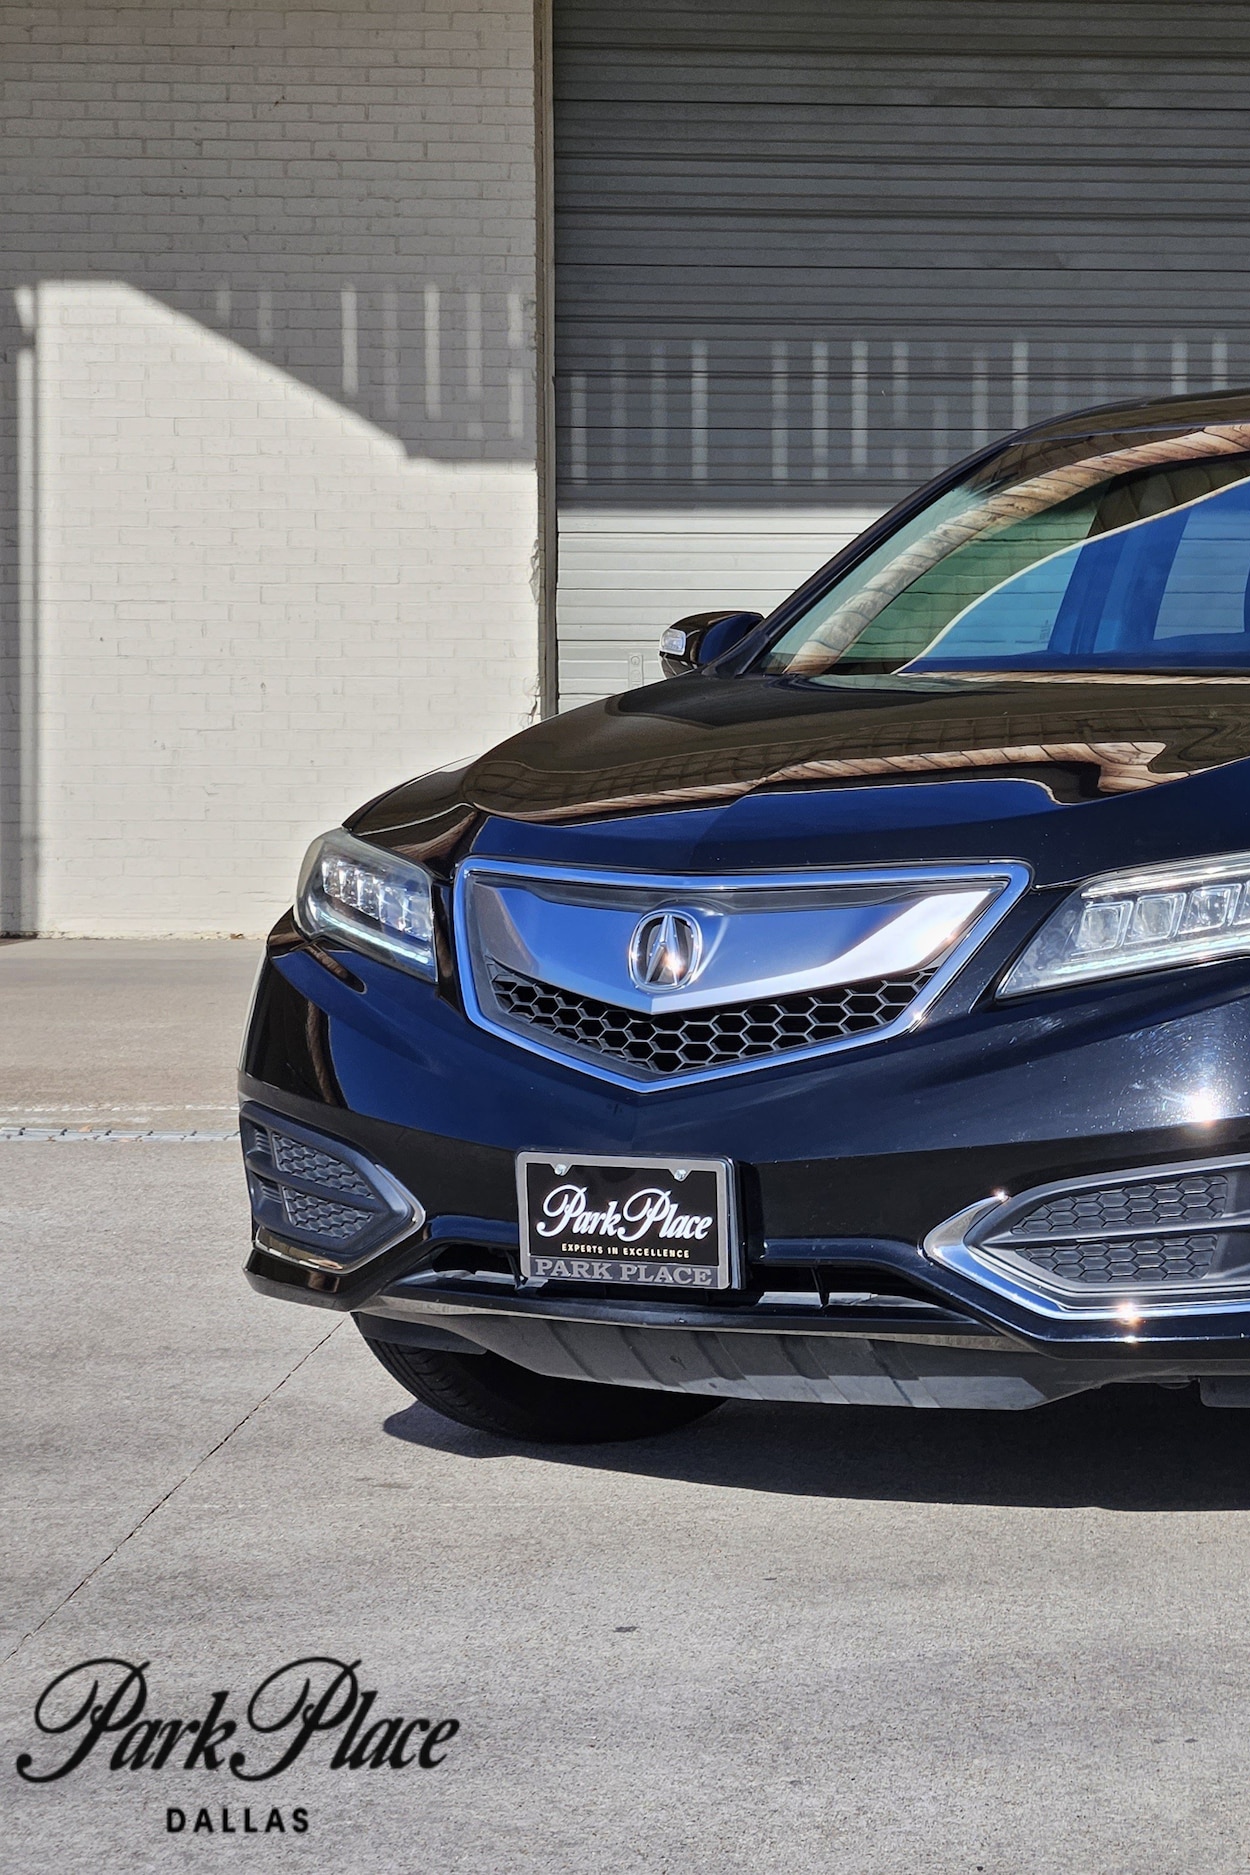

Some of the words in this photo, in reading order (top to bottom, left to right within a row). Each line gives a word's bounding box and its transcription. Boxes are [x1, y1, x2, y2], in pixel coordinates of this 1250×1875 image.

[536, 1184, 623, 1237] Park
[617, 1188, 713, 1242] Place
[561, 1243, 603, 1254] EXPERTS
[607, 1246, 619, 1255] IN
[623, 1247, 690, 1259] EXCELLENCE
[535, 1258, 613, 1280] PARK
[619, 1264, 713, 1286] PLACE
